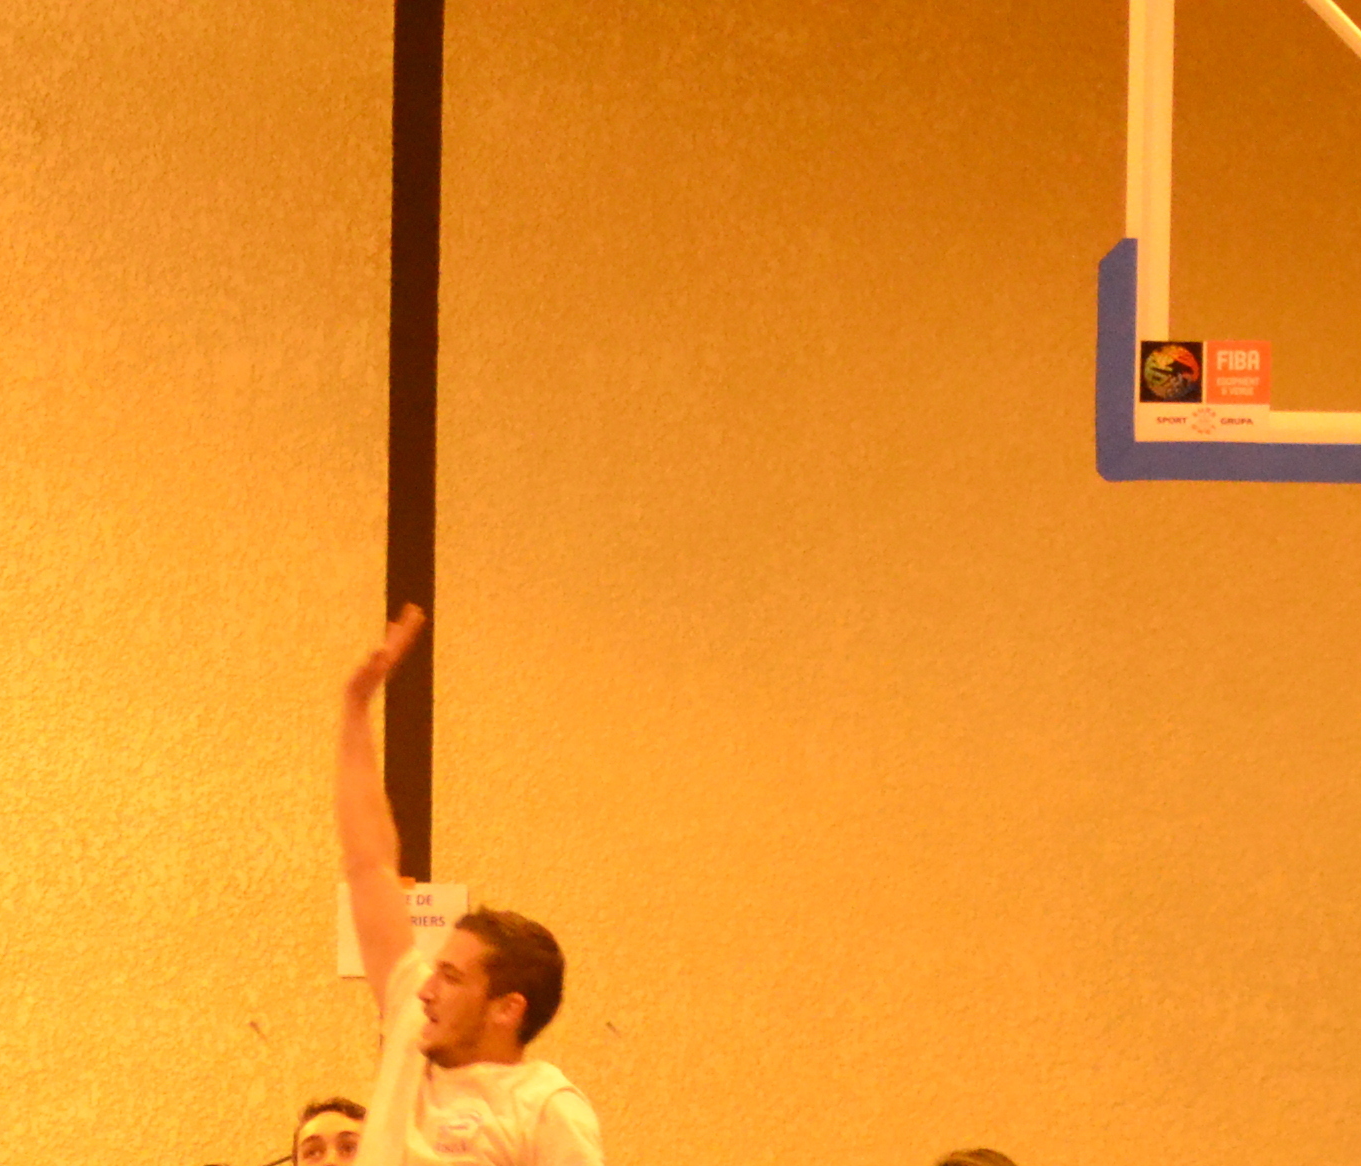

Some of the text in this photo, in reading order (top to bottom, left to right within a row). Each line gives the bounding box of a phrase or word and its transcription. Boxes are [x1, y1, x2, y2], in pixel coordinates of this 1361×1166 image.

[1216, 349, 1260, 371] FIBA
[1156, 416, 1253, 425] SPORT GRUPA
[416, 895, 433, 906] DE
